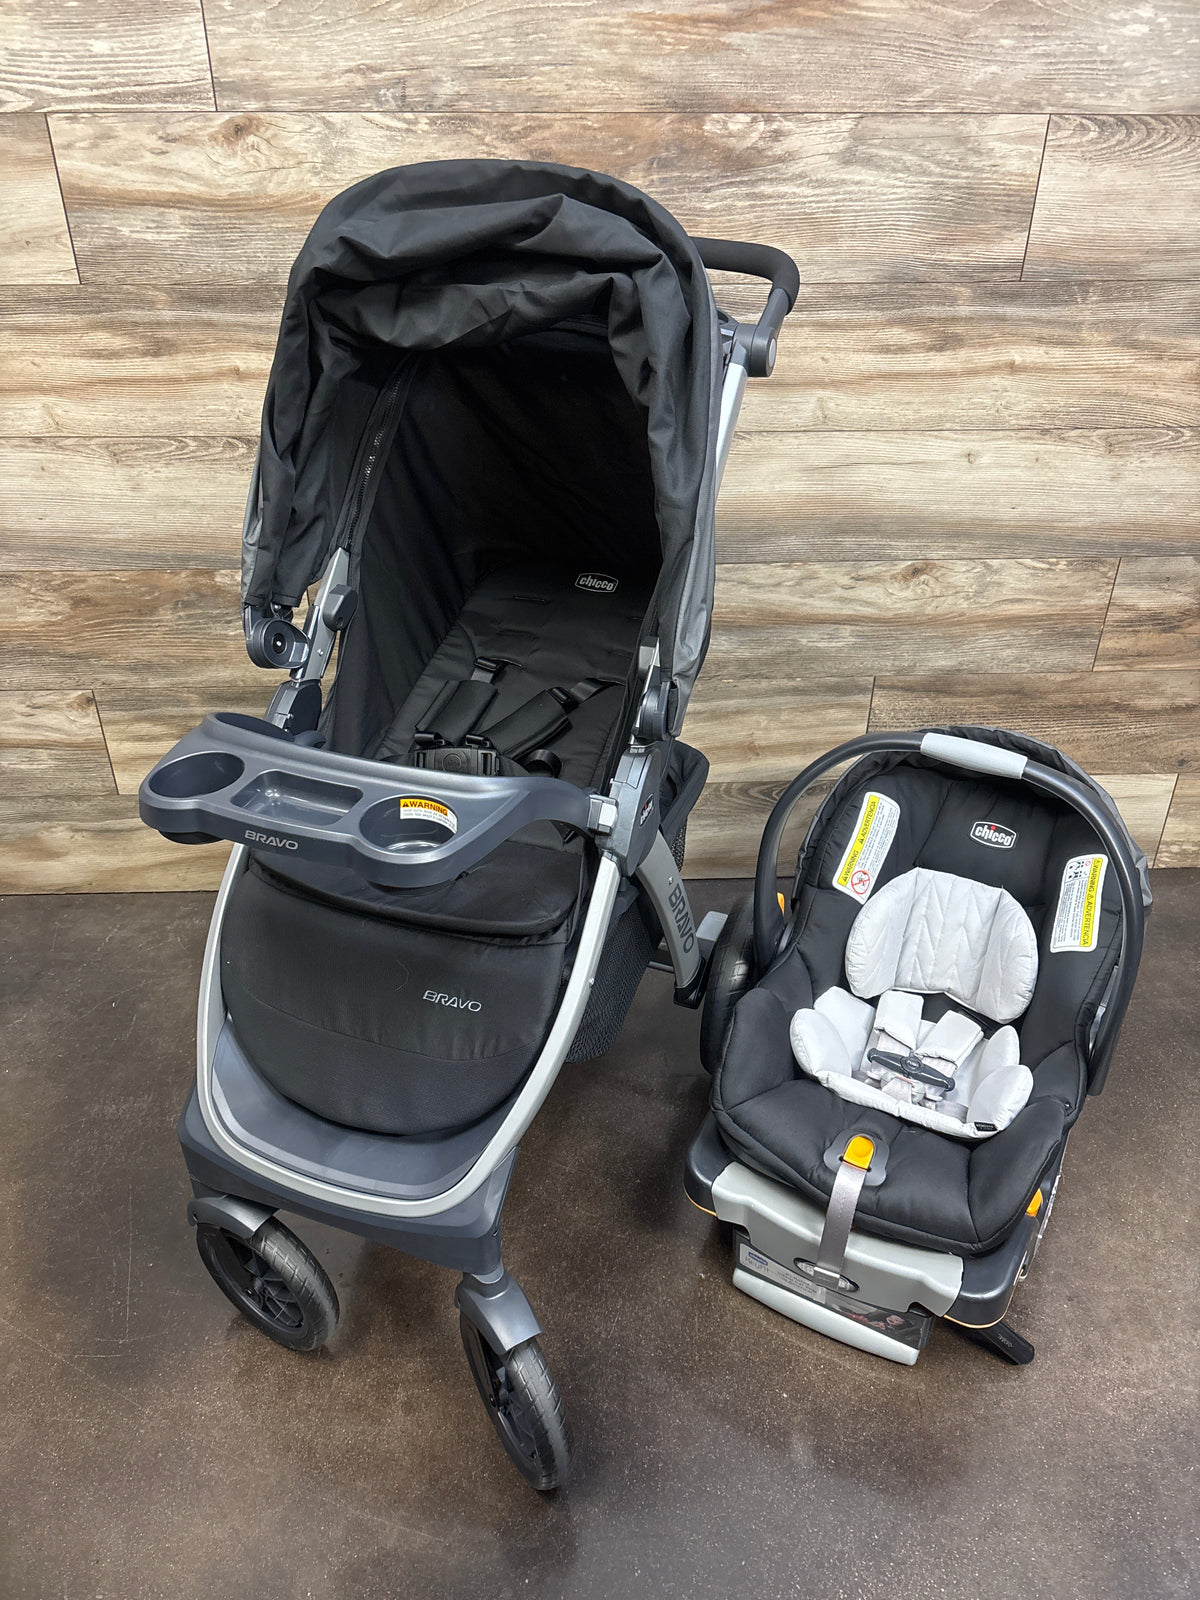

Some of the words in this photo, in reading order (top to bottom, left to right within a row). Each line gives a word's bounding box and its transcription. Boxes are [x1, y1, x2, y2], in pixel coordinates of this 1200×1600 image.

[579, 575, 614, 591] chicco
[409, 801, 448, 816] WARNING
[244, 830, 299, 850] BRAVO
[844, 850, 859, 878] WARNING
[861, 801, 877, 839] ADVERTENCIA
[975, 825, 1012, 846] chicco
[1089, 864, 1100, 893] WARNING
[668, 883, 695, 953] BRAVO
[1082, 901, 1093, 946] ADVERTENCIA
[422, 990, 482, 1012] BRAVO
